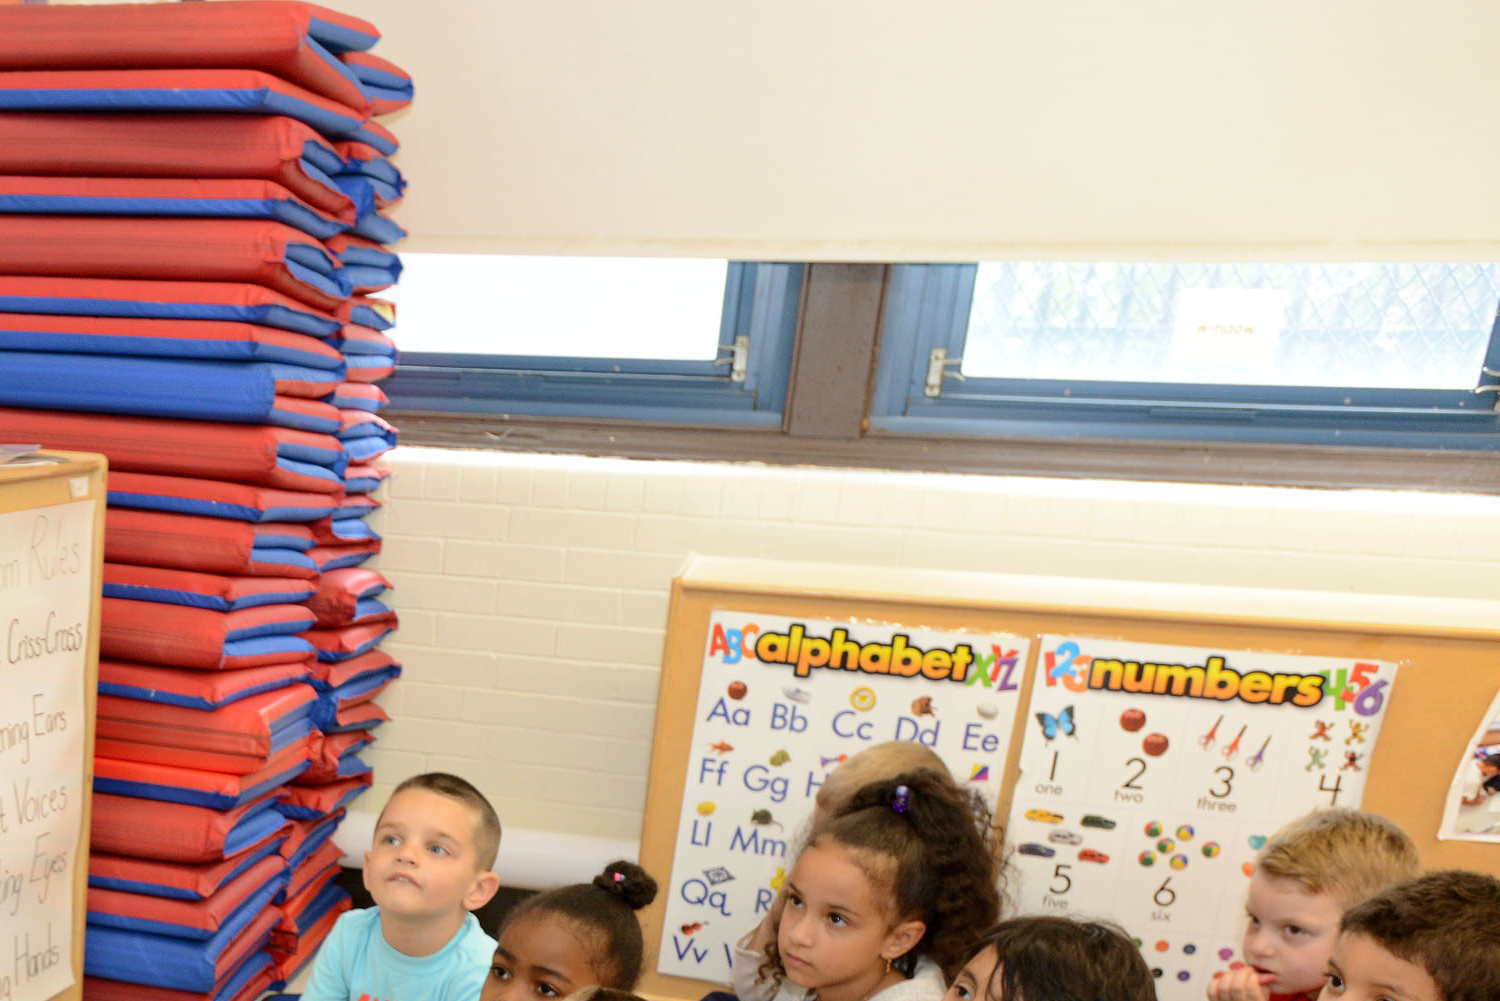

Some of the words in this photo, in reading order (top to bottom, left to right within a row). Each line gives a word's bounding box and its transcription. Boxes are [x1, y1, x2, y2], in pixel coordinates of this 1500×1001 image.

[29, 514, 81, 584] Rules
[7, 610, 83, 664] Criss-Cross
[708, 622, 760, 664] ABC
[754, 623, 975, 683] alphabet
[964, 643, 1019, 692] XYZ
[1044, 640, 1094, 694] 123
[1086, 655, 1328, 709] numbers
[1320, 661, 1389, 717] 456
[32, 693, 68, 736] Ears
[706, 696, 751, 728] Aa
[769, 702, 808, 733] Bb
[831, 709, 874, 742] Cc
[895, 716, 941, 748] Dd
[962, 722, 1000, 753] Ee
[12, 777, 68, 825] Voices
[698, 757, 730, 787] Ff
[743, 763, 790, 803] Gg
[1034, 782, 1064, 797] one
[1114, 788, 1145, 805] two
[1196, 794, 1238, 814] three
[1124, 756, 1149, 791] 2
[1209, 765, 1235, 799] 3
[1318, 772, 1344, 806] 4
[730, 825, 788, 858] Mm
[29, 831, 69, 904] Eyes
[1049, 864, 1073, 896] 5
[1153, 876, 1176, 907] 6
[680, 877, 732, 917] Qq
[1042, 894, 1069, 911] five
[1150, 909, 1172, 923] six
[14, 920, 61, 987] Hands
[672, 936, 708, 964] Vv
